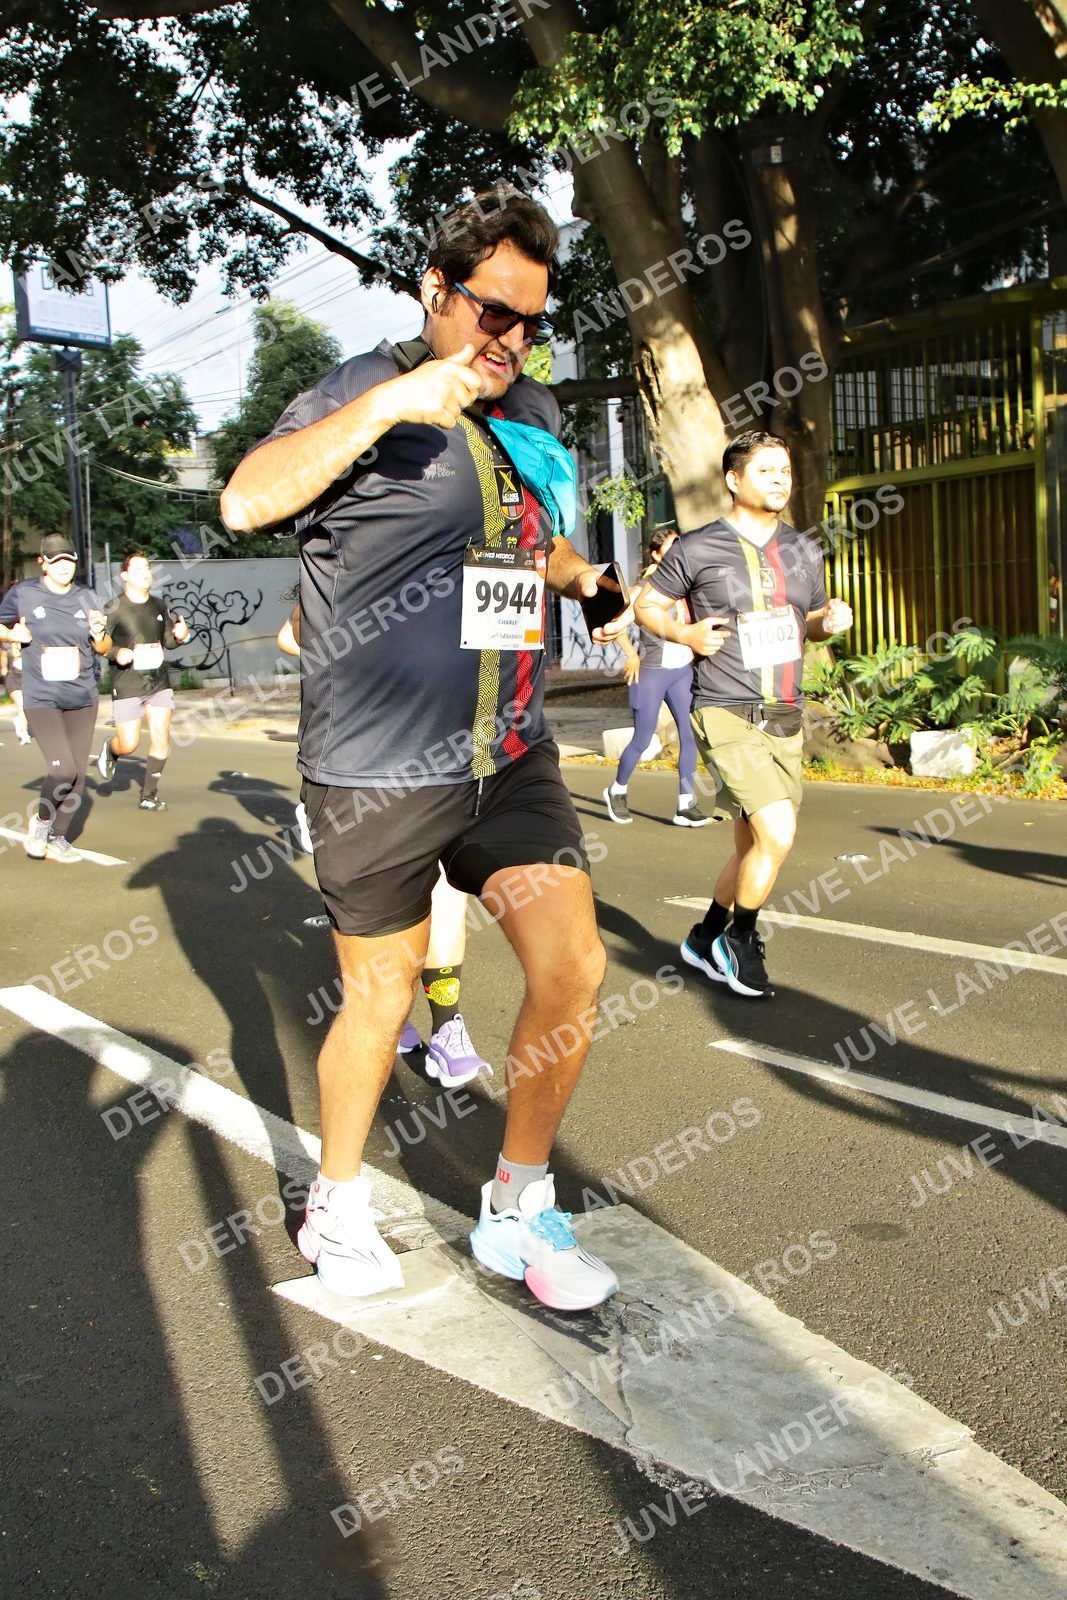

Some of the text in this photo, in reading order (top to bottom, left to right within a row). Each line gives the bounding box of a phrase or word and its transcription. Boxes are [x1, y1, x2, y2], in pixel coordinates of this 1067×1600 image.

[163, 578, 204, 594] TOY
[475, 580, 537, 614] 9944
[743, 624, 795, 648] 11002
